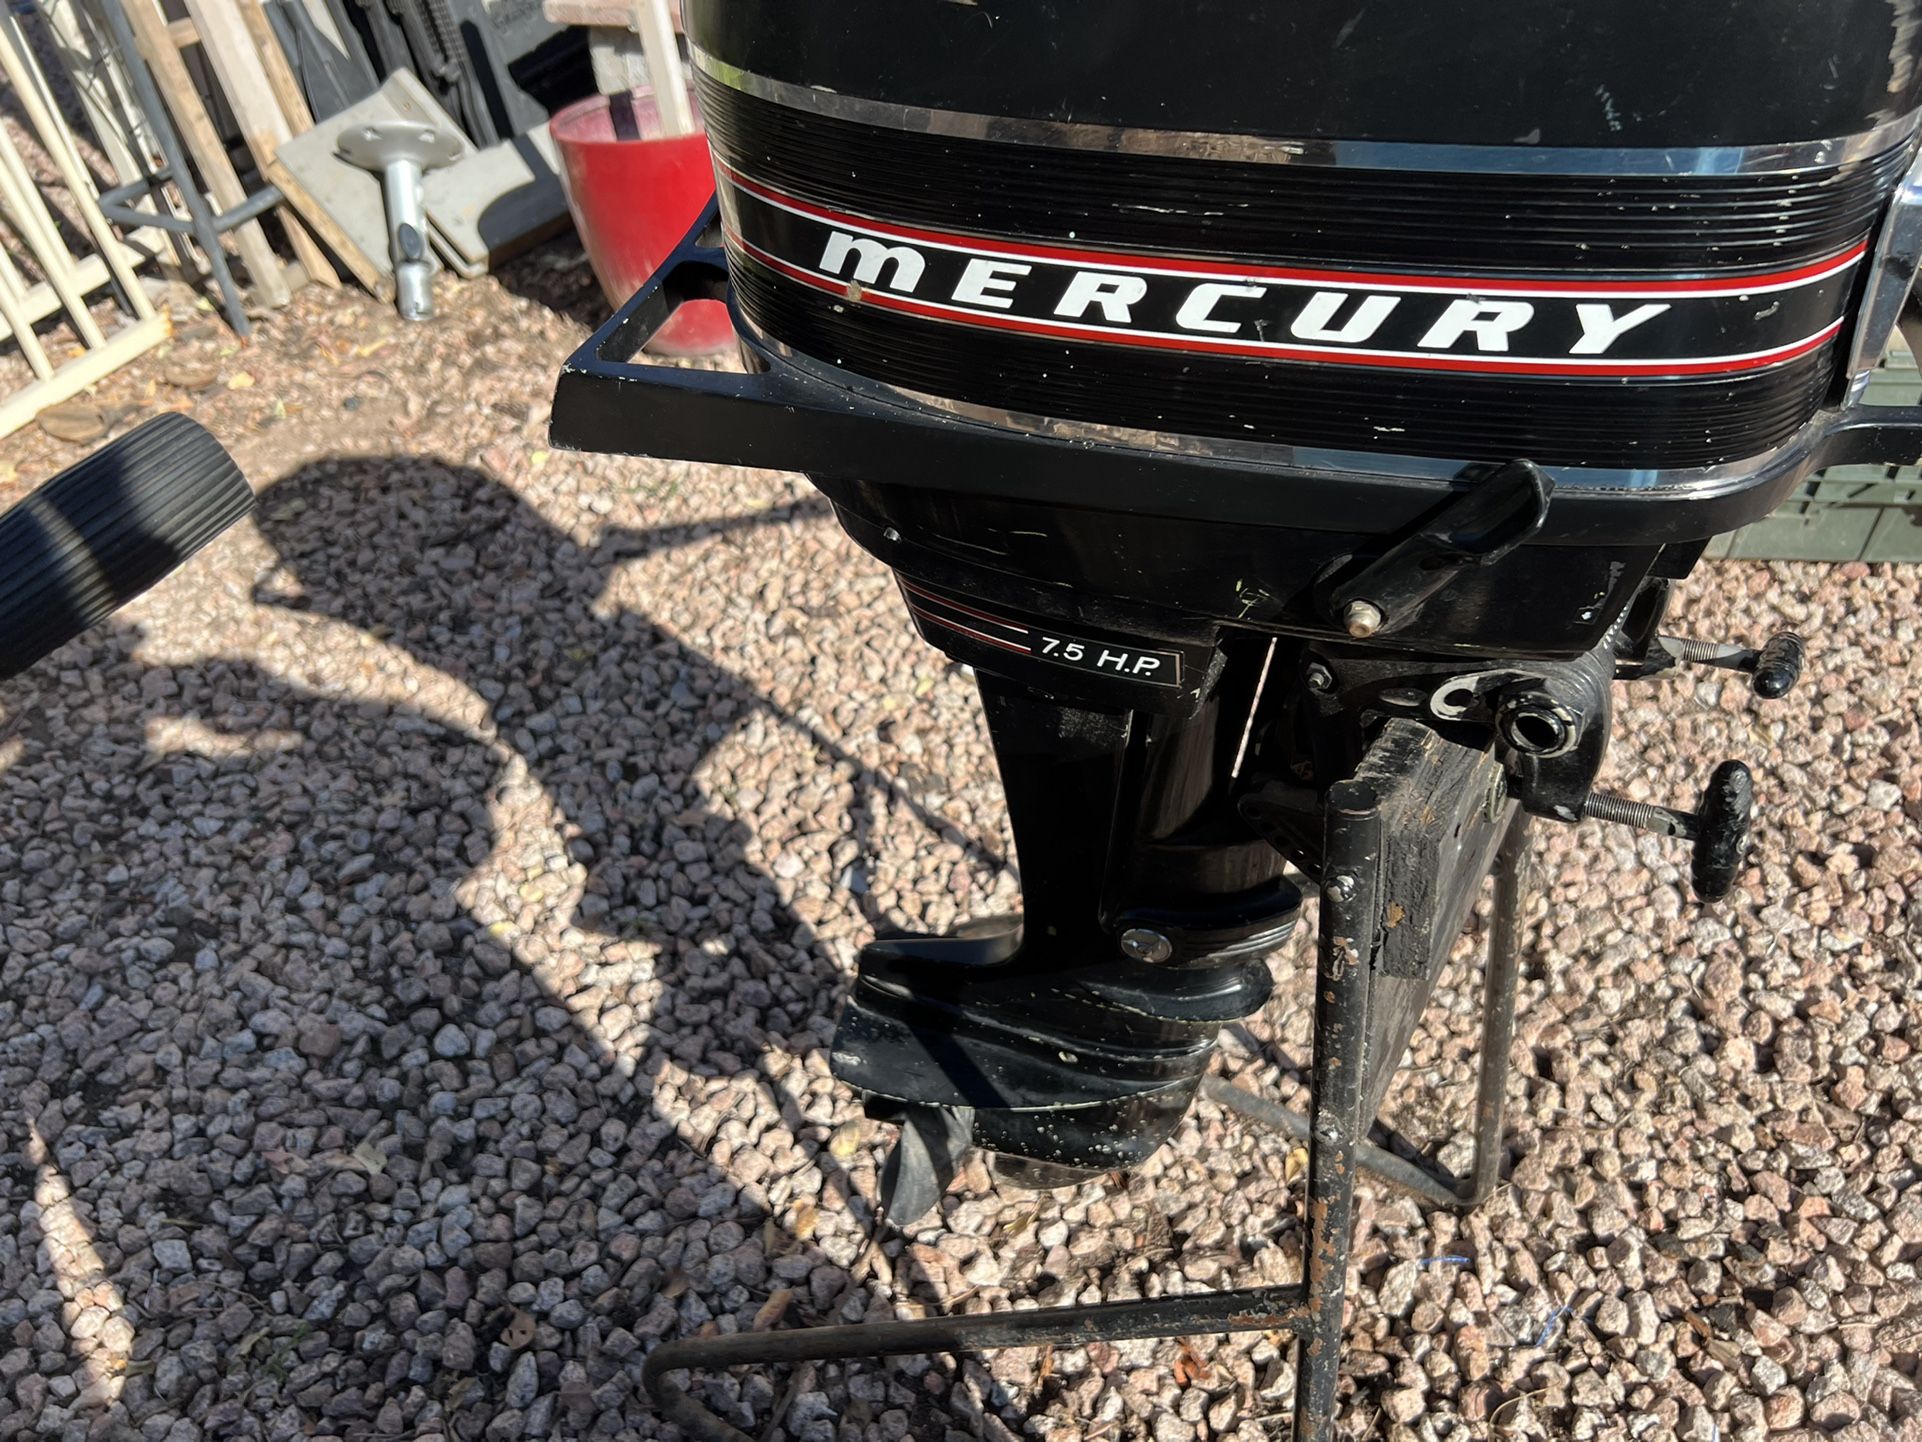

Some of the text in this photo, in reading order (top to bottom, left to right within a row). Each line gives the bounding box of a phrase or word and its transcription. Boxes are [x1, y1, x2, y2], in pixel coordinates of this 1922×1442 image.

[818, 230, 1671, 355] MERCURY
[1042, 636, 1161, 676] 7.5 H.P.
